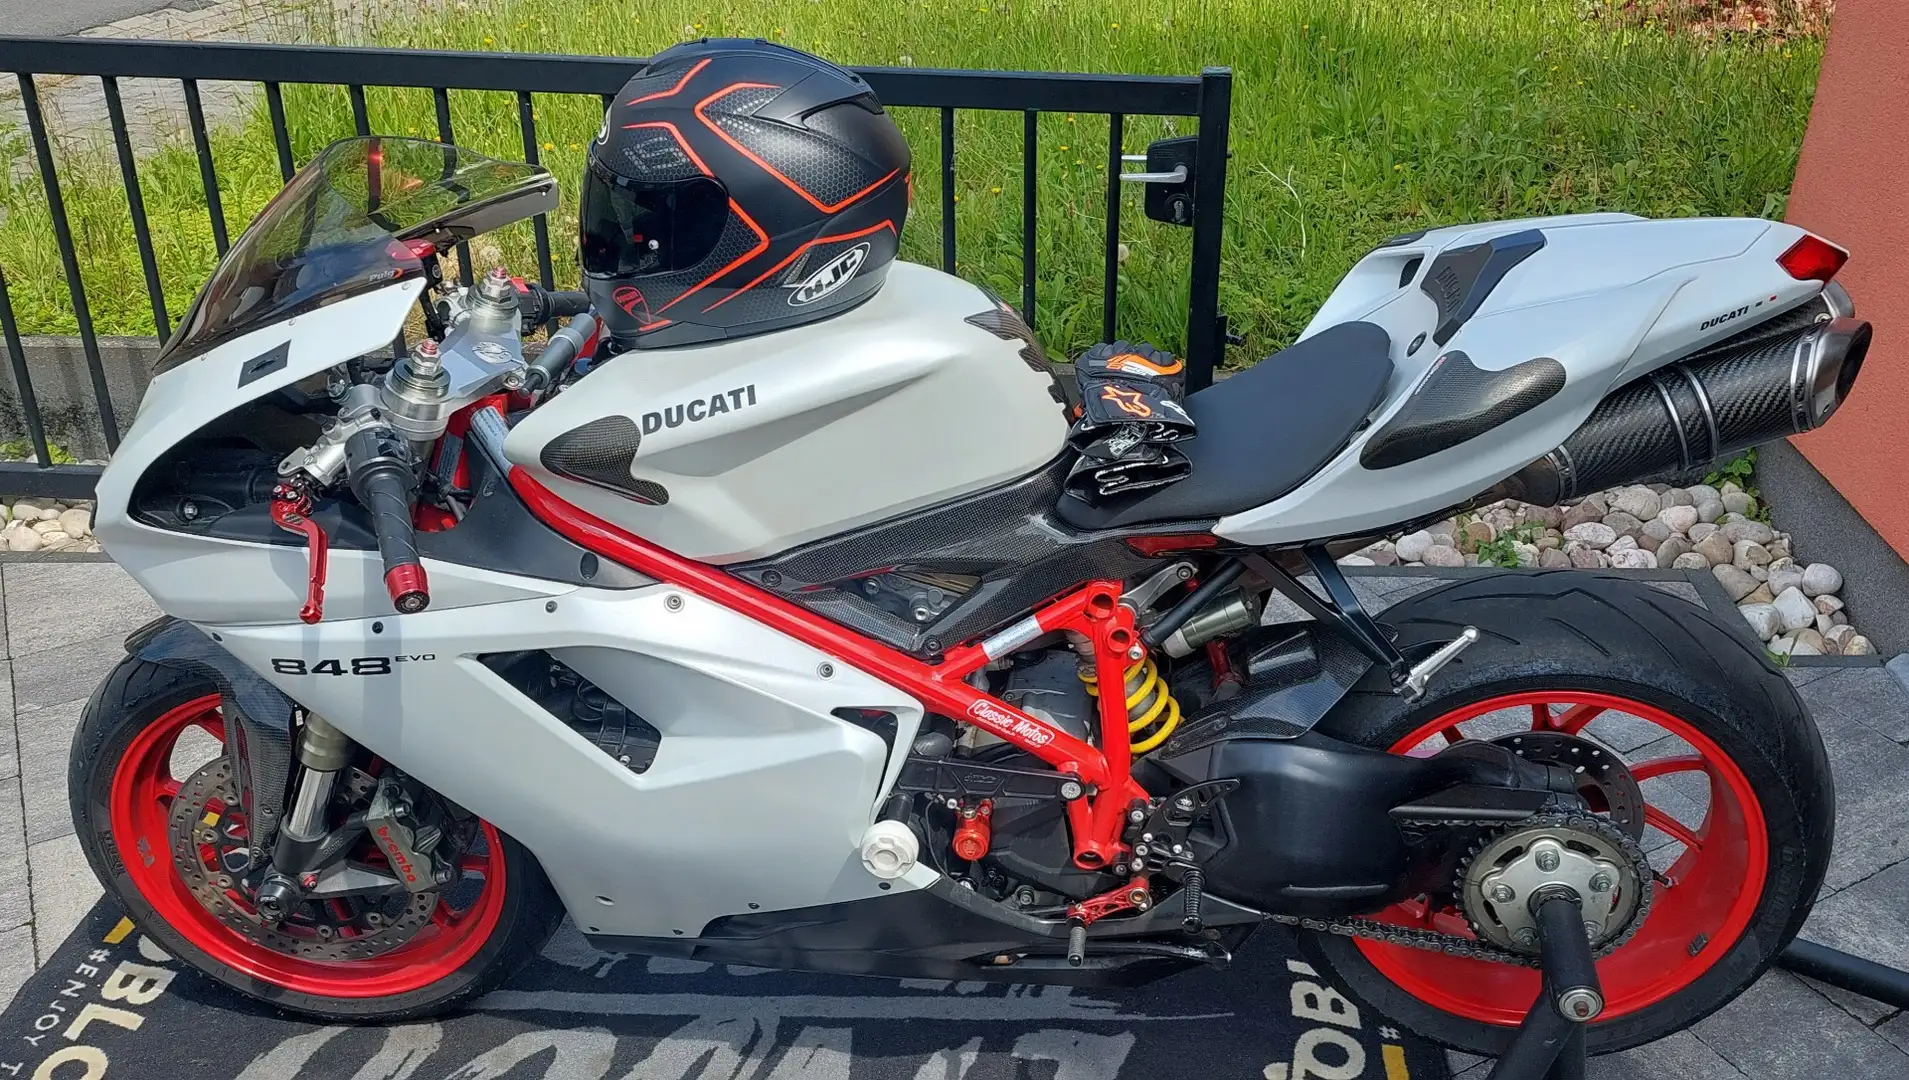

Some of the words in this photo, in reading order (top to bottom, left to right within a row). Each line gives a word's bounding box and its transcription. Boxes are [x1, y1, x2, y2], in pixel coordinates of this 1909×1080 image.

[803, 249, 858, 300] HJC
[1700, 305, 1749, 331] DUCATI
[642, 384, 757, 436] DUCATI
[271, 657, 392, 676] 848
[395, 653, 436, 662] EVO
[973, 701, 1014, 728] Classic
[1011, 720, 1049, 744] Motos
[376, 825, 417, 882] brembo
